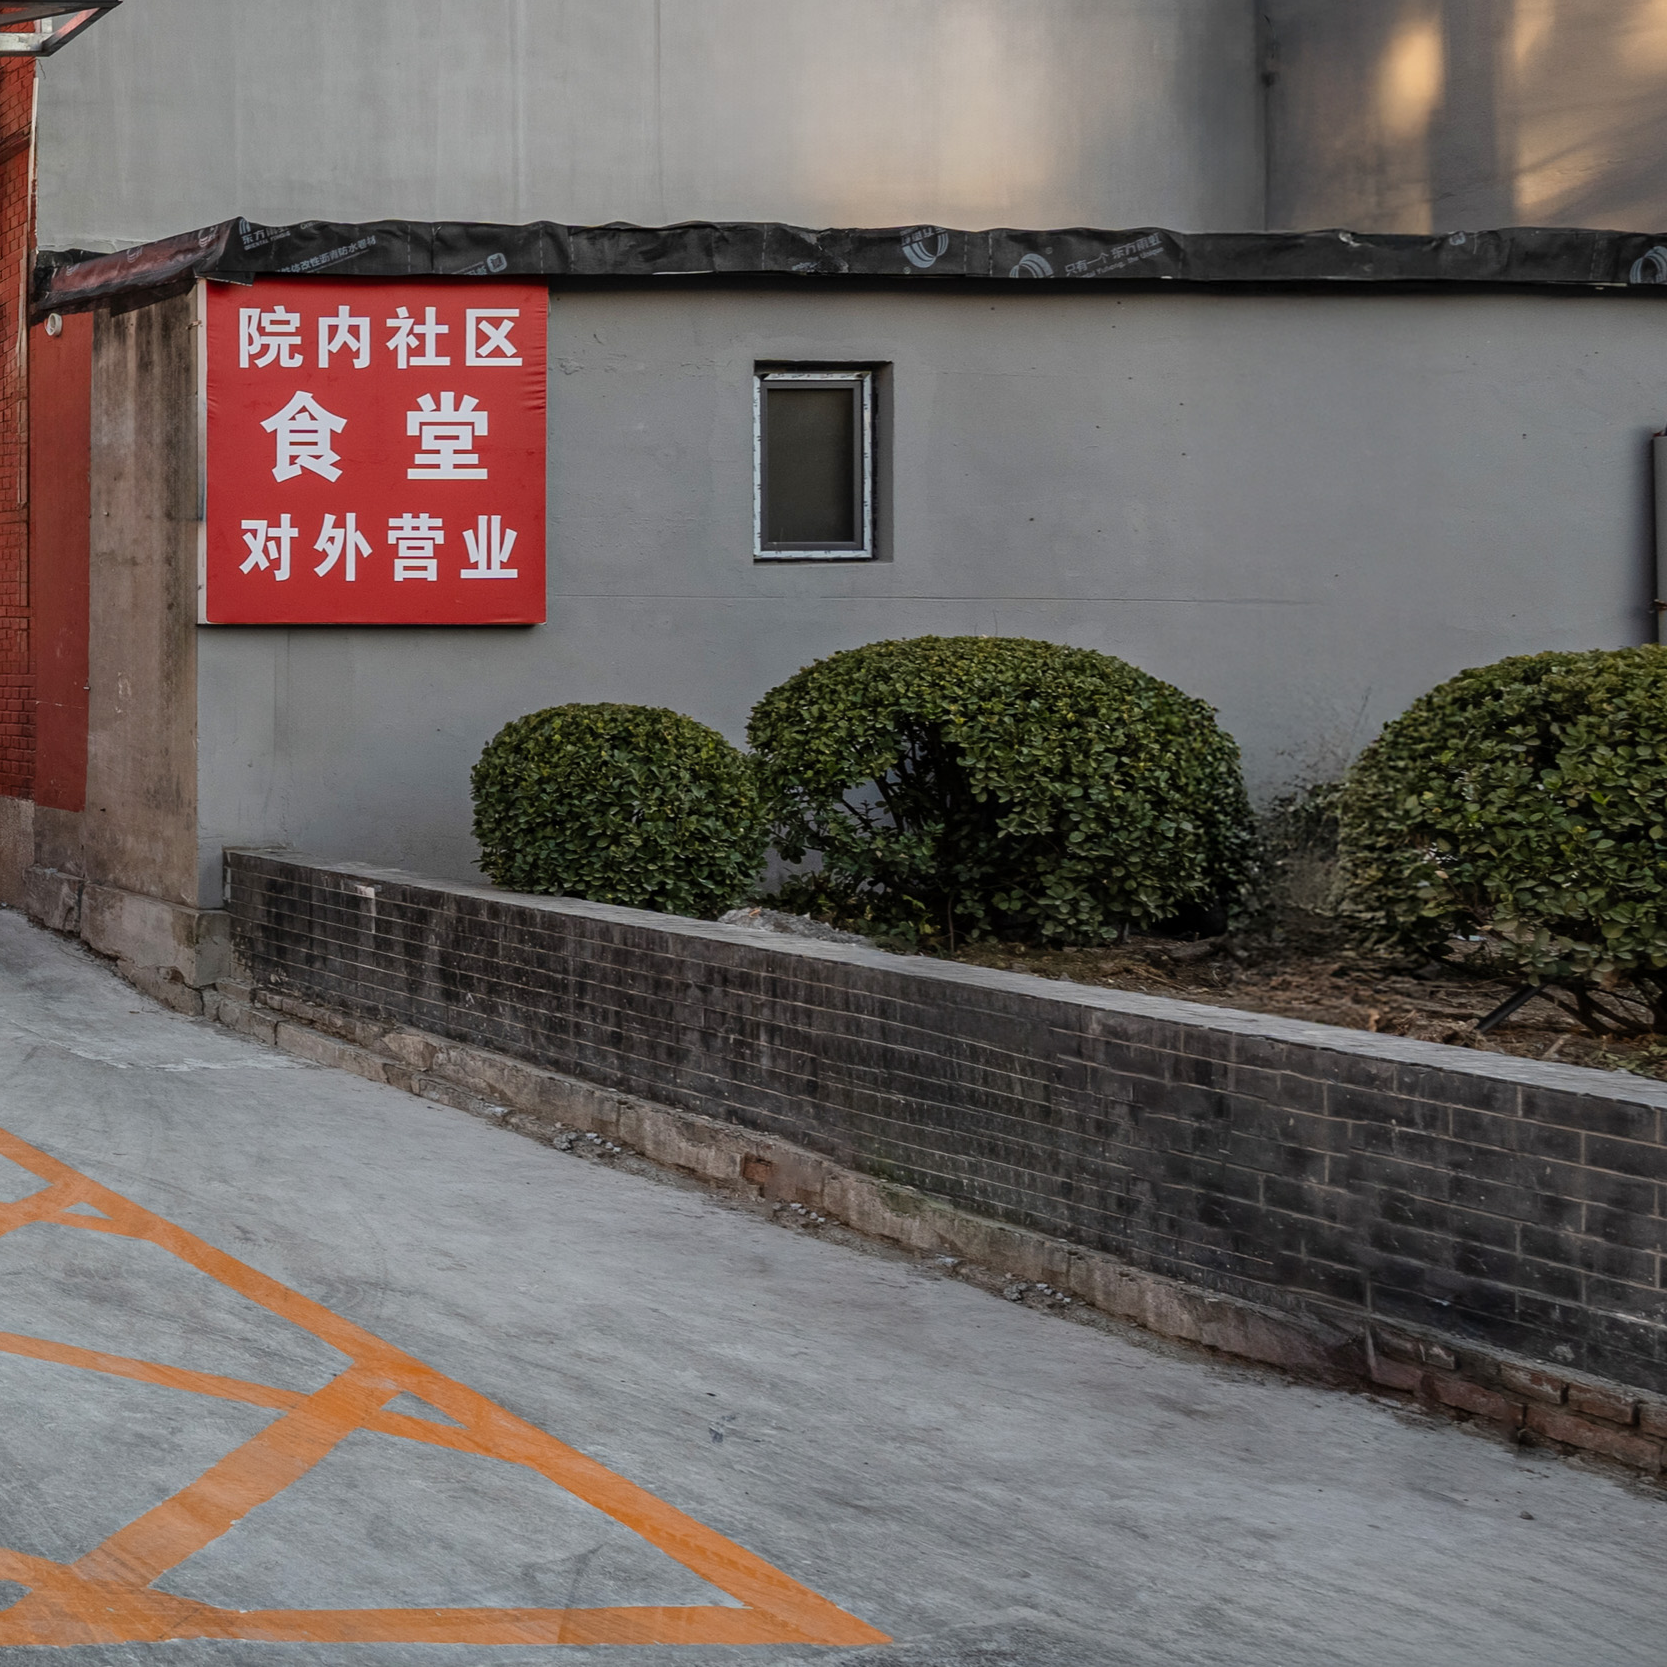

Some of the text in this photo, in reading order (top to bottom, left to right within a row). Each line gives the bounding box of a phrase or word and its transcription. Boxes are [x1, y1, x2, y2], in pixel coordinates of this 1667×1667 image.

[238, 305, 524, 370] 院内社区
[259, 390, 489, 483] 食堂
[238, 512, 519, 582] 对外营业
